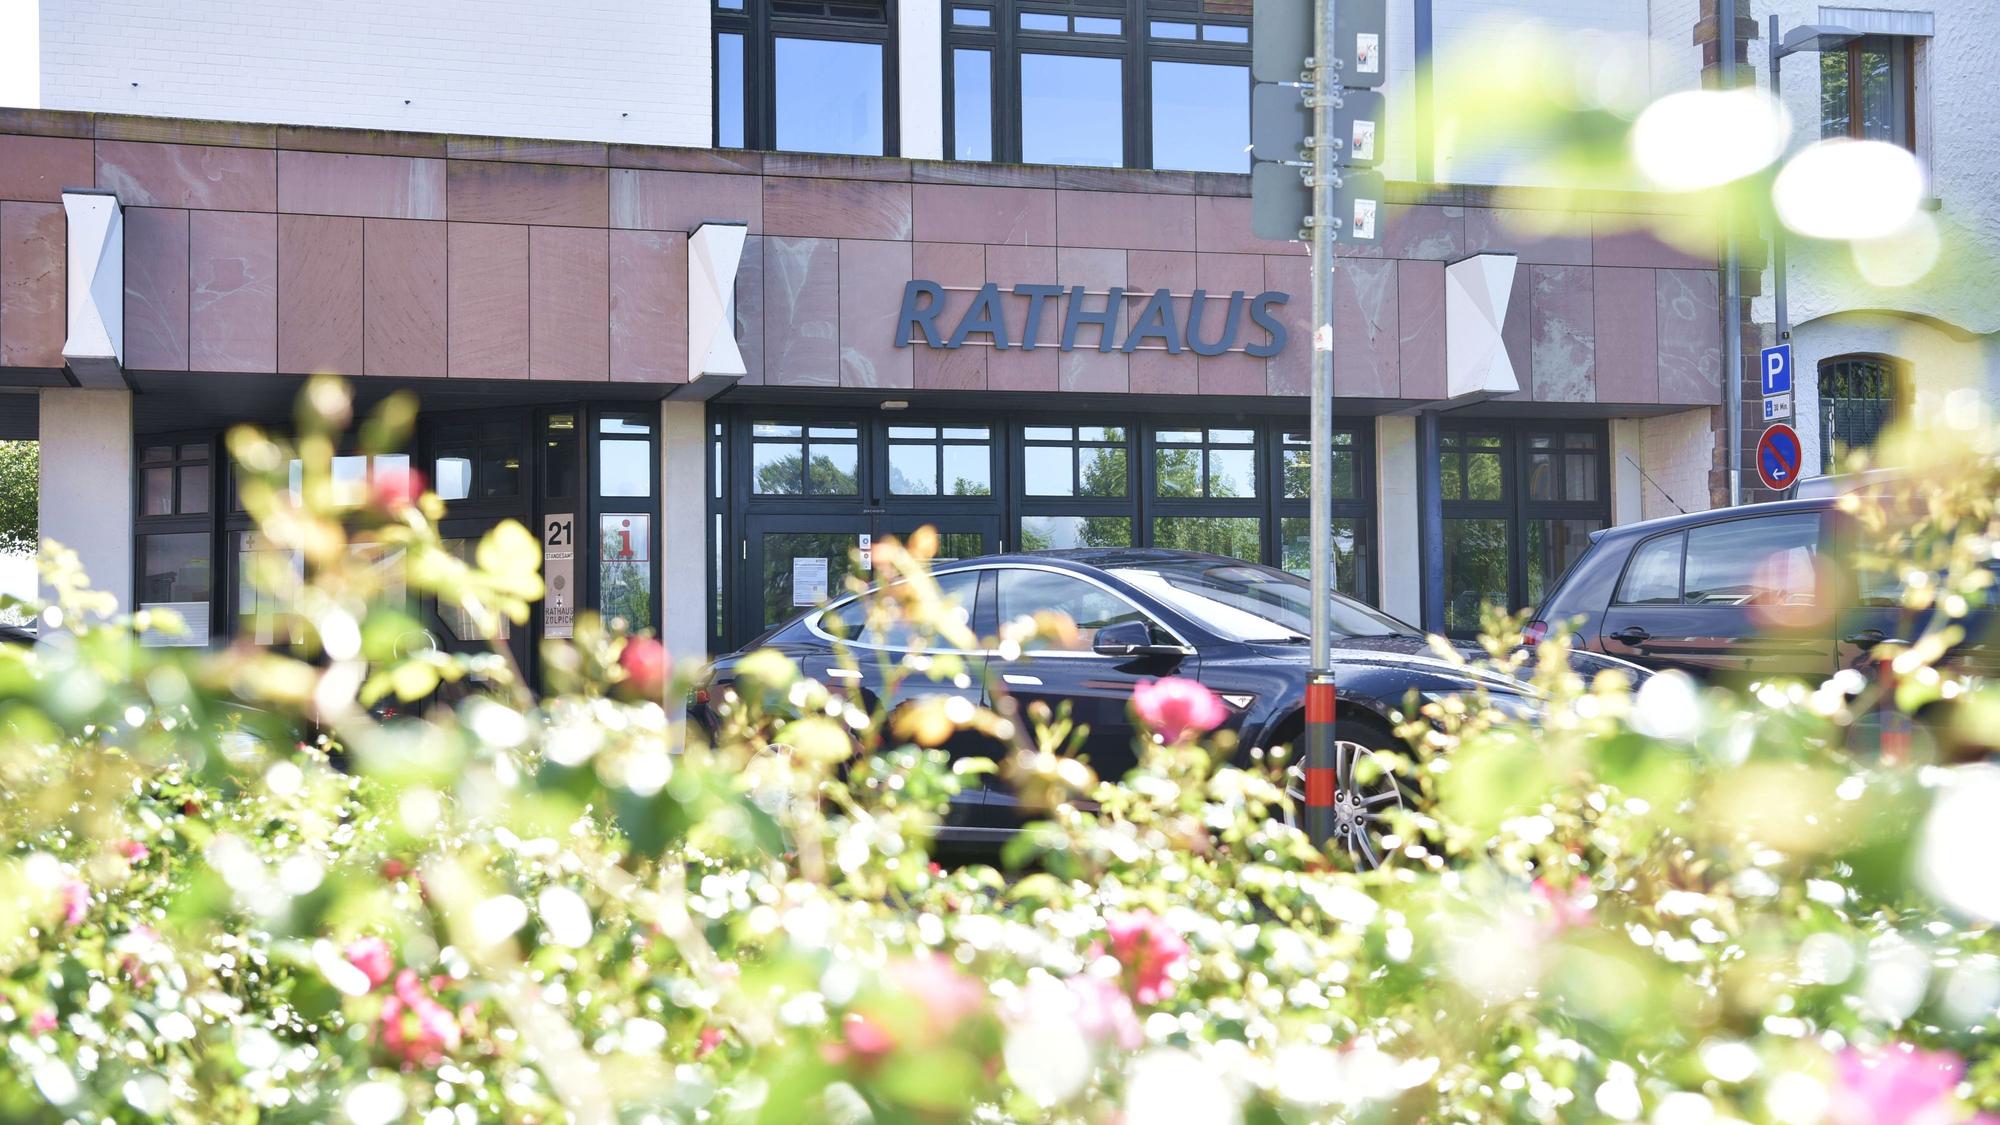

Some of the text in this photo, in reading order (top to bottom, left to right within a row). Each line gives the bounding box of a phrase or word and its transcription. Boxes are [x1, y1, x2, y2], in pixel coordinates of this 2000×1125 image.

[895, 280, 1290, 357] RATHAUS
[1768, 353, 1783, 388] P
[548, 521, 571, 545] 21
[545, 607, 574, 615] RATHAUS
